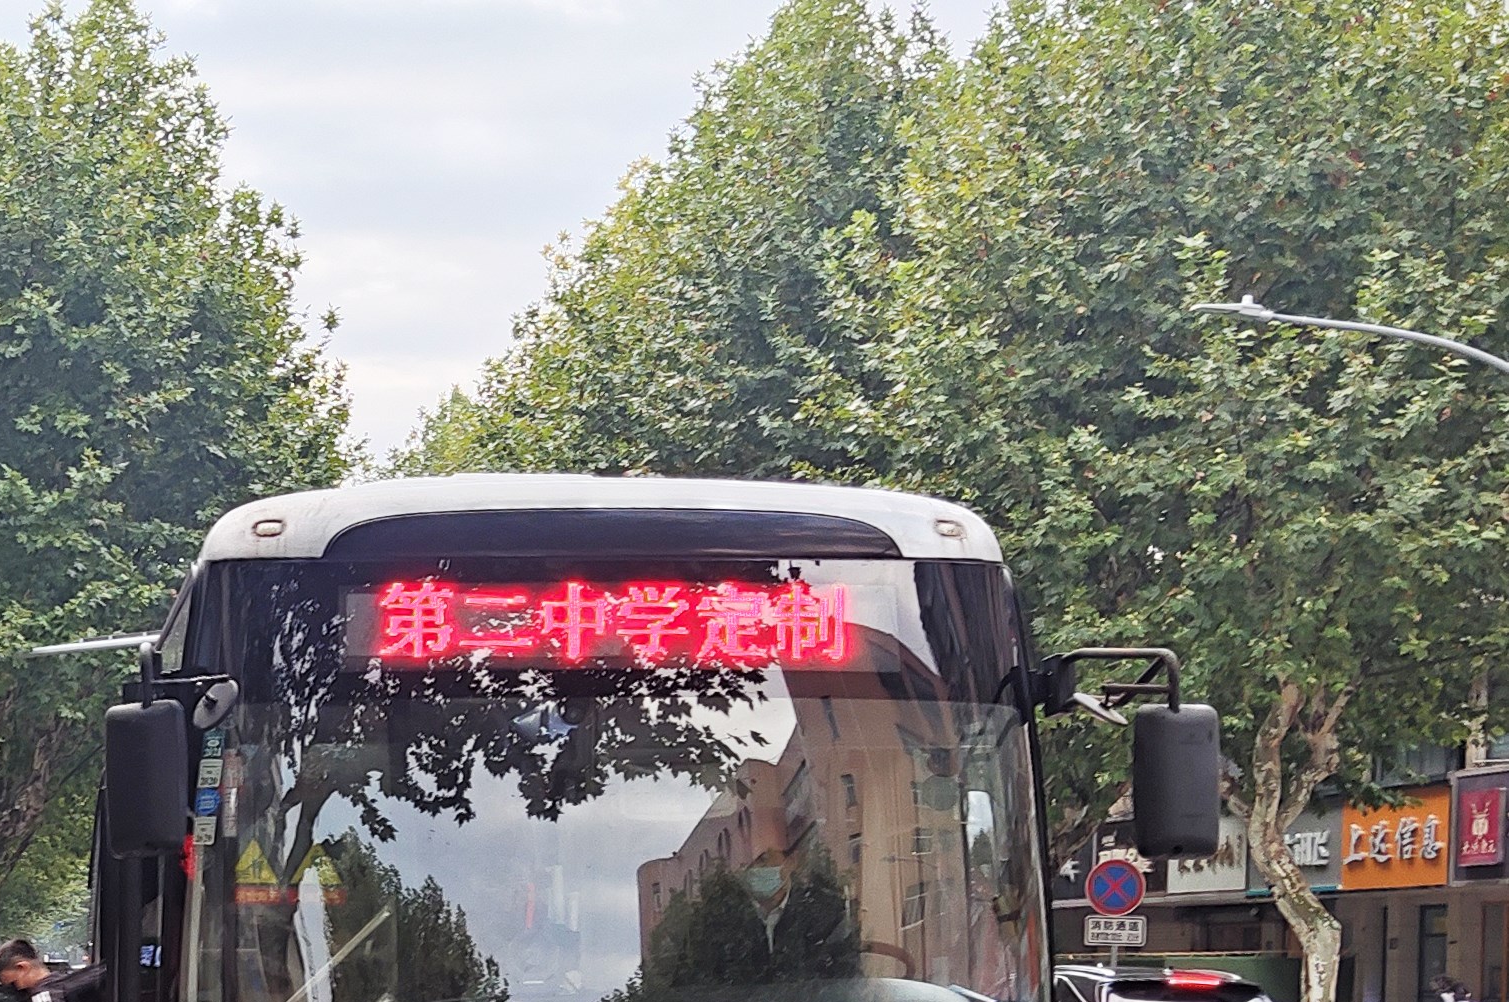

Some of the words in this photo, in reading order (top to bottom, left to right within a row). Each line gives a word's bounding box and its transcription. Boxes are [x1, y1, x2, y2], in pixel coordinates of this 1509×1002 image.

[379, 580, 847, 662] 第二中学定制
[1342, 813, 1447, 866] 上达信息
